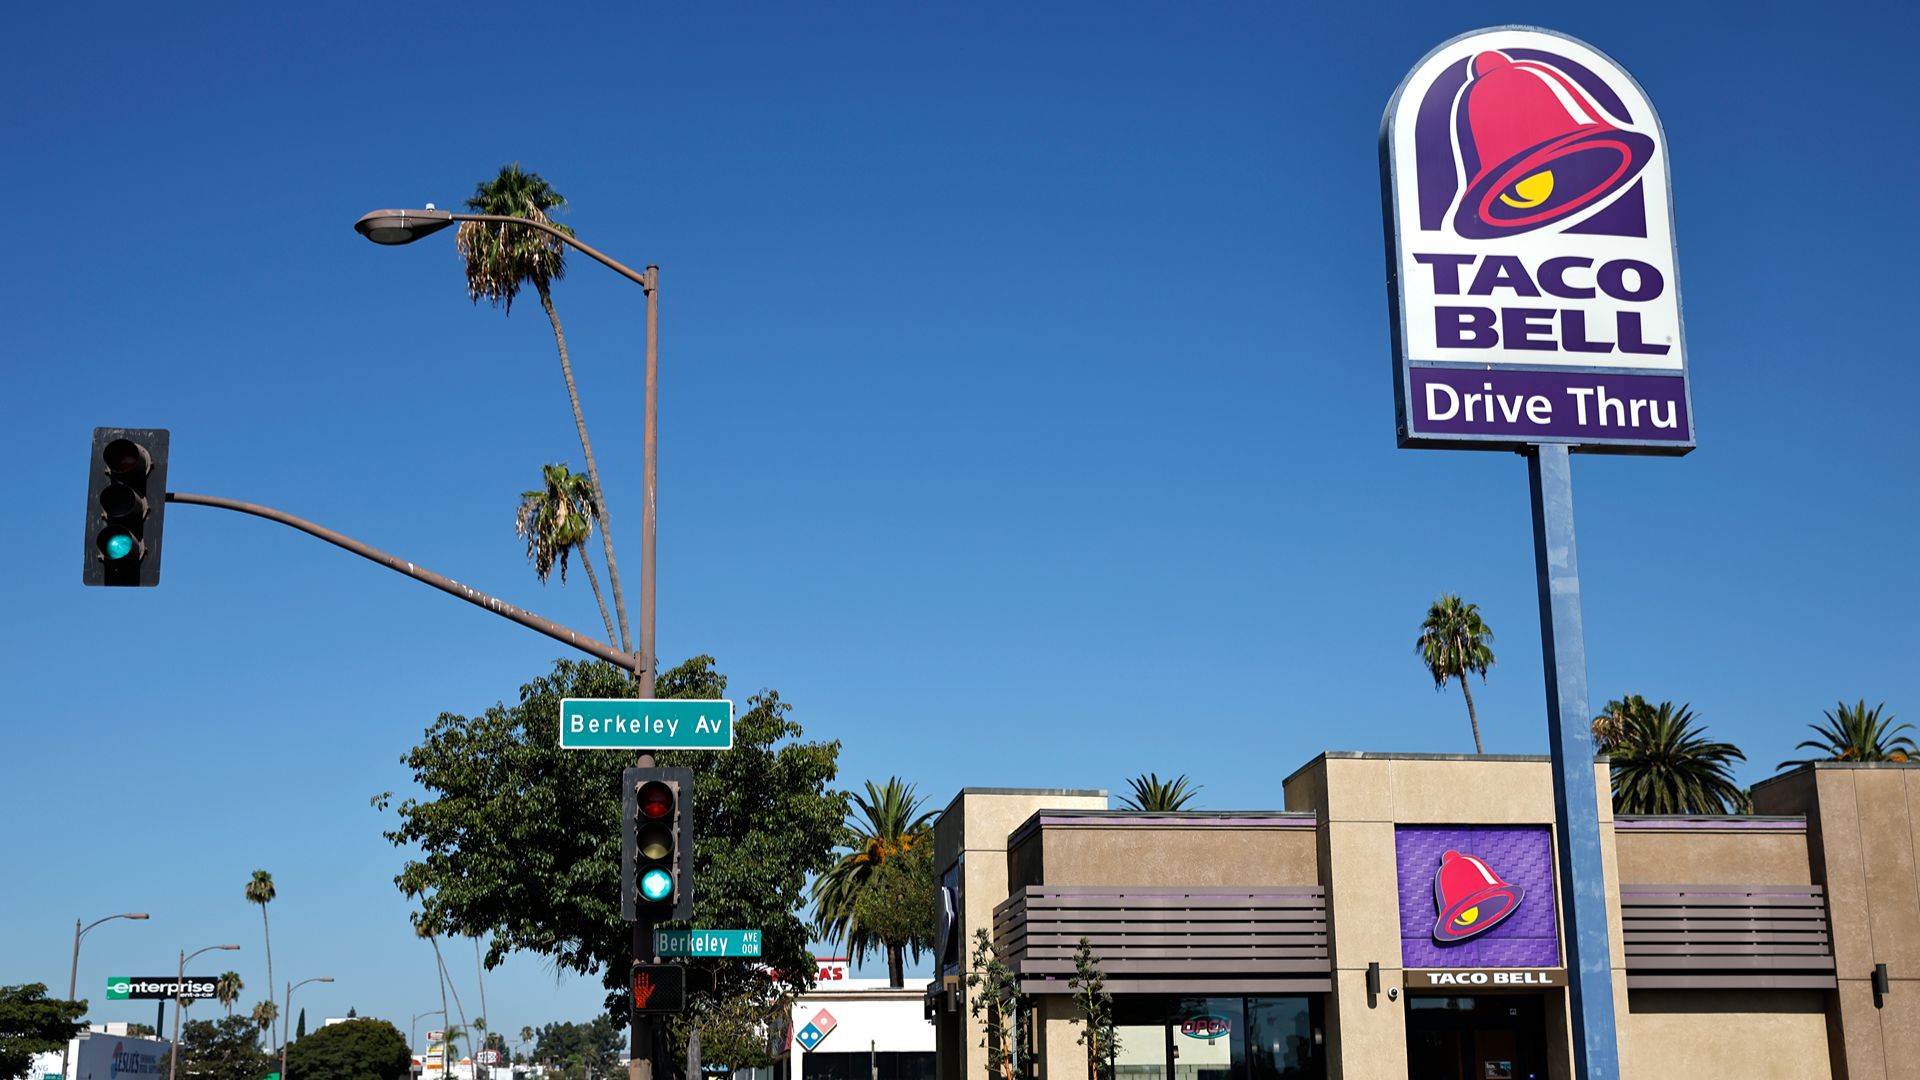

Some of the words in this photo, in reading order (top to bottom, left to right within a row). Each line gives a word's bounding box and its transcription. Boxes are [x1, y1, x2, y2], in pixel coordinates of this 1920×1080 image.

[1414, 254, 1664, 302] TACO
[1434, 306, 1671, 355] BELL
[1424, 383, 1553, 424] Drive
[1566, 386, 1677, 429] Thru
[570, 713, 679, 736] Berkeley
[695, 715, 722, 733] Av
[660, 933, 729, 955] Berkeley
[743, 933, 758, 943] AVE
[109, 980, 215, 995] enterprise
[1427, 973, 1487, 985] TACO
[1493, 973, 1552, 985] BELL
[1183, 1019, 1232, 1034] OPEN
